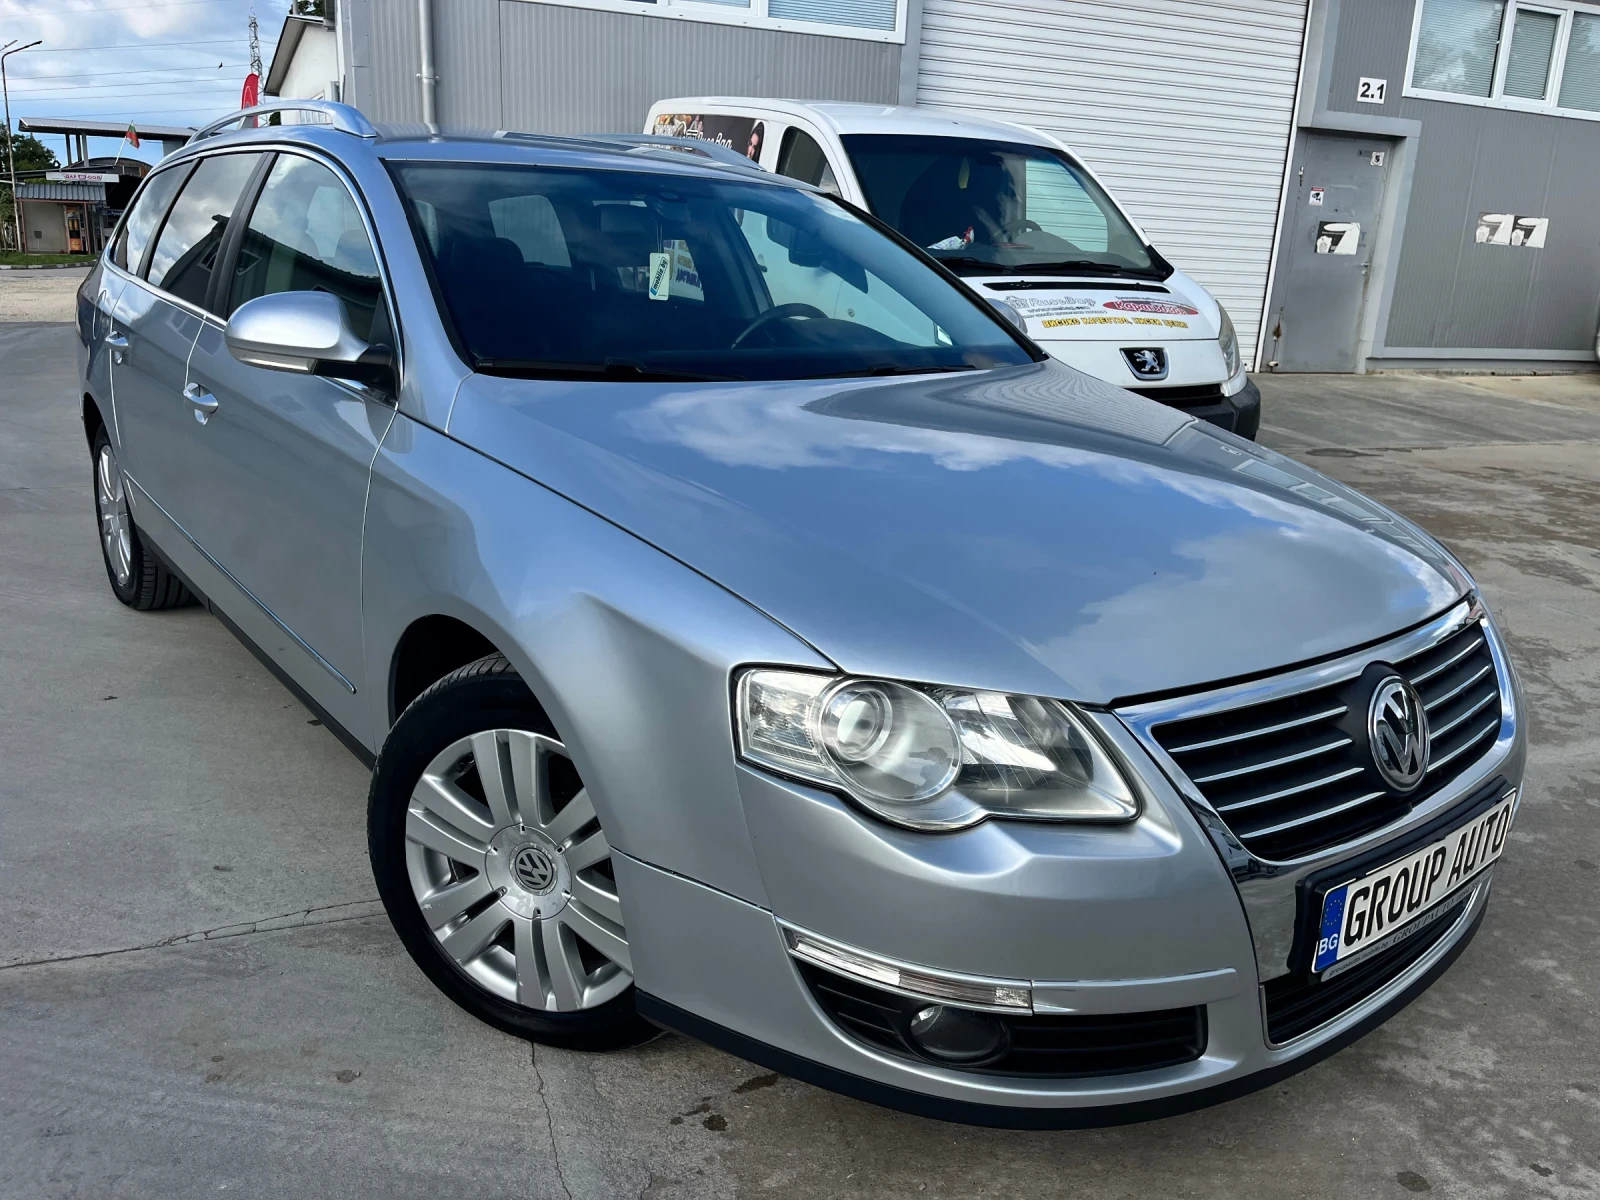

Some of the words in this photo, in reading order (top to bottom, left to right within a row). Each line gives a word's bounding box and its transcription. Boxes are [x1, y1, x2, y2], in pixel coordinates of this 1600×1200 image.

[1360, 82, 1385, 100] 2.1
[653, 259, 669, 290] mobile.bg
[1042, 318, 1081, 329] ВИСОКО
[1343, 846, 1447, 947] GROUP
[1446, 803, 1510, 889] AUTO
[1393, 898, 1455, 943] GROUPAUTO
[1318, 933, 1339, 956] BG
